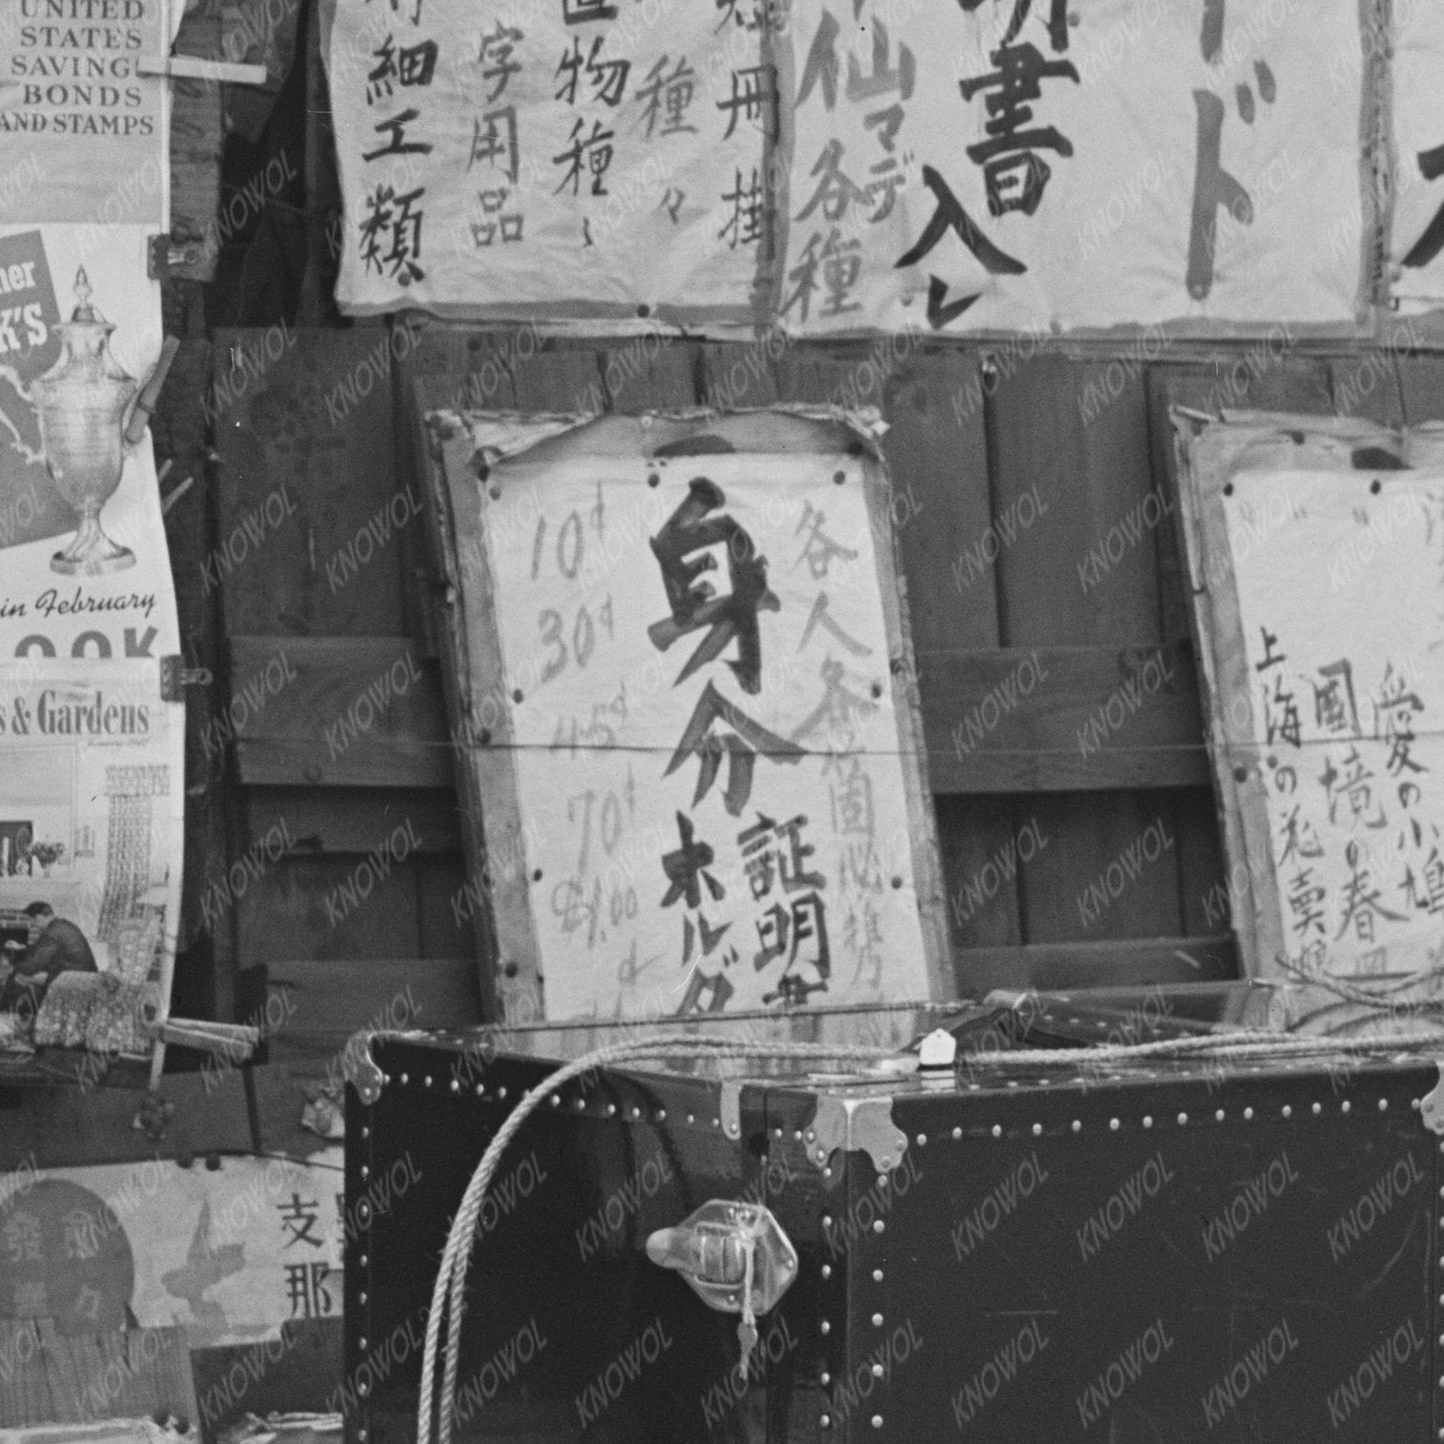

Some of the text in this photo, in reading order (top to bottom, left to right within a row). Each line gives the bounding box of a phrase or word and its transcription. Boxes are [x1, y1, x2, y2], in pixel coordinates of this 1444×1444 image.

[20, 26, 143, 51] STATES
[22, 84, 143, 109] BONDS
[52, 113, 155, 137] STAMPS
[0, 598, 27, 619] in
[35, 586, 159, 617] February
[11, 696, 32, 737] &
[36, 689, 151, 738] Gardens
[1314, 657, 1409, 946] 國境の春
[275, 1192, 332, 1319] 支那
